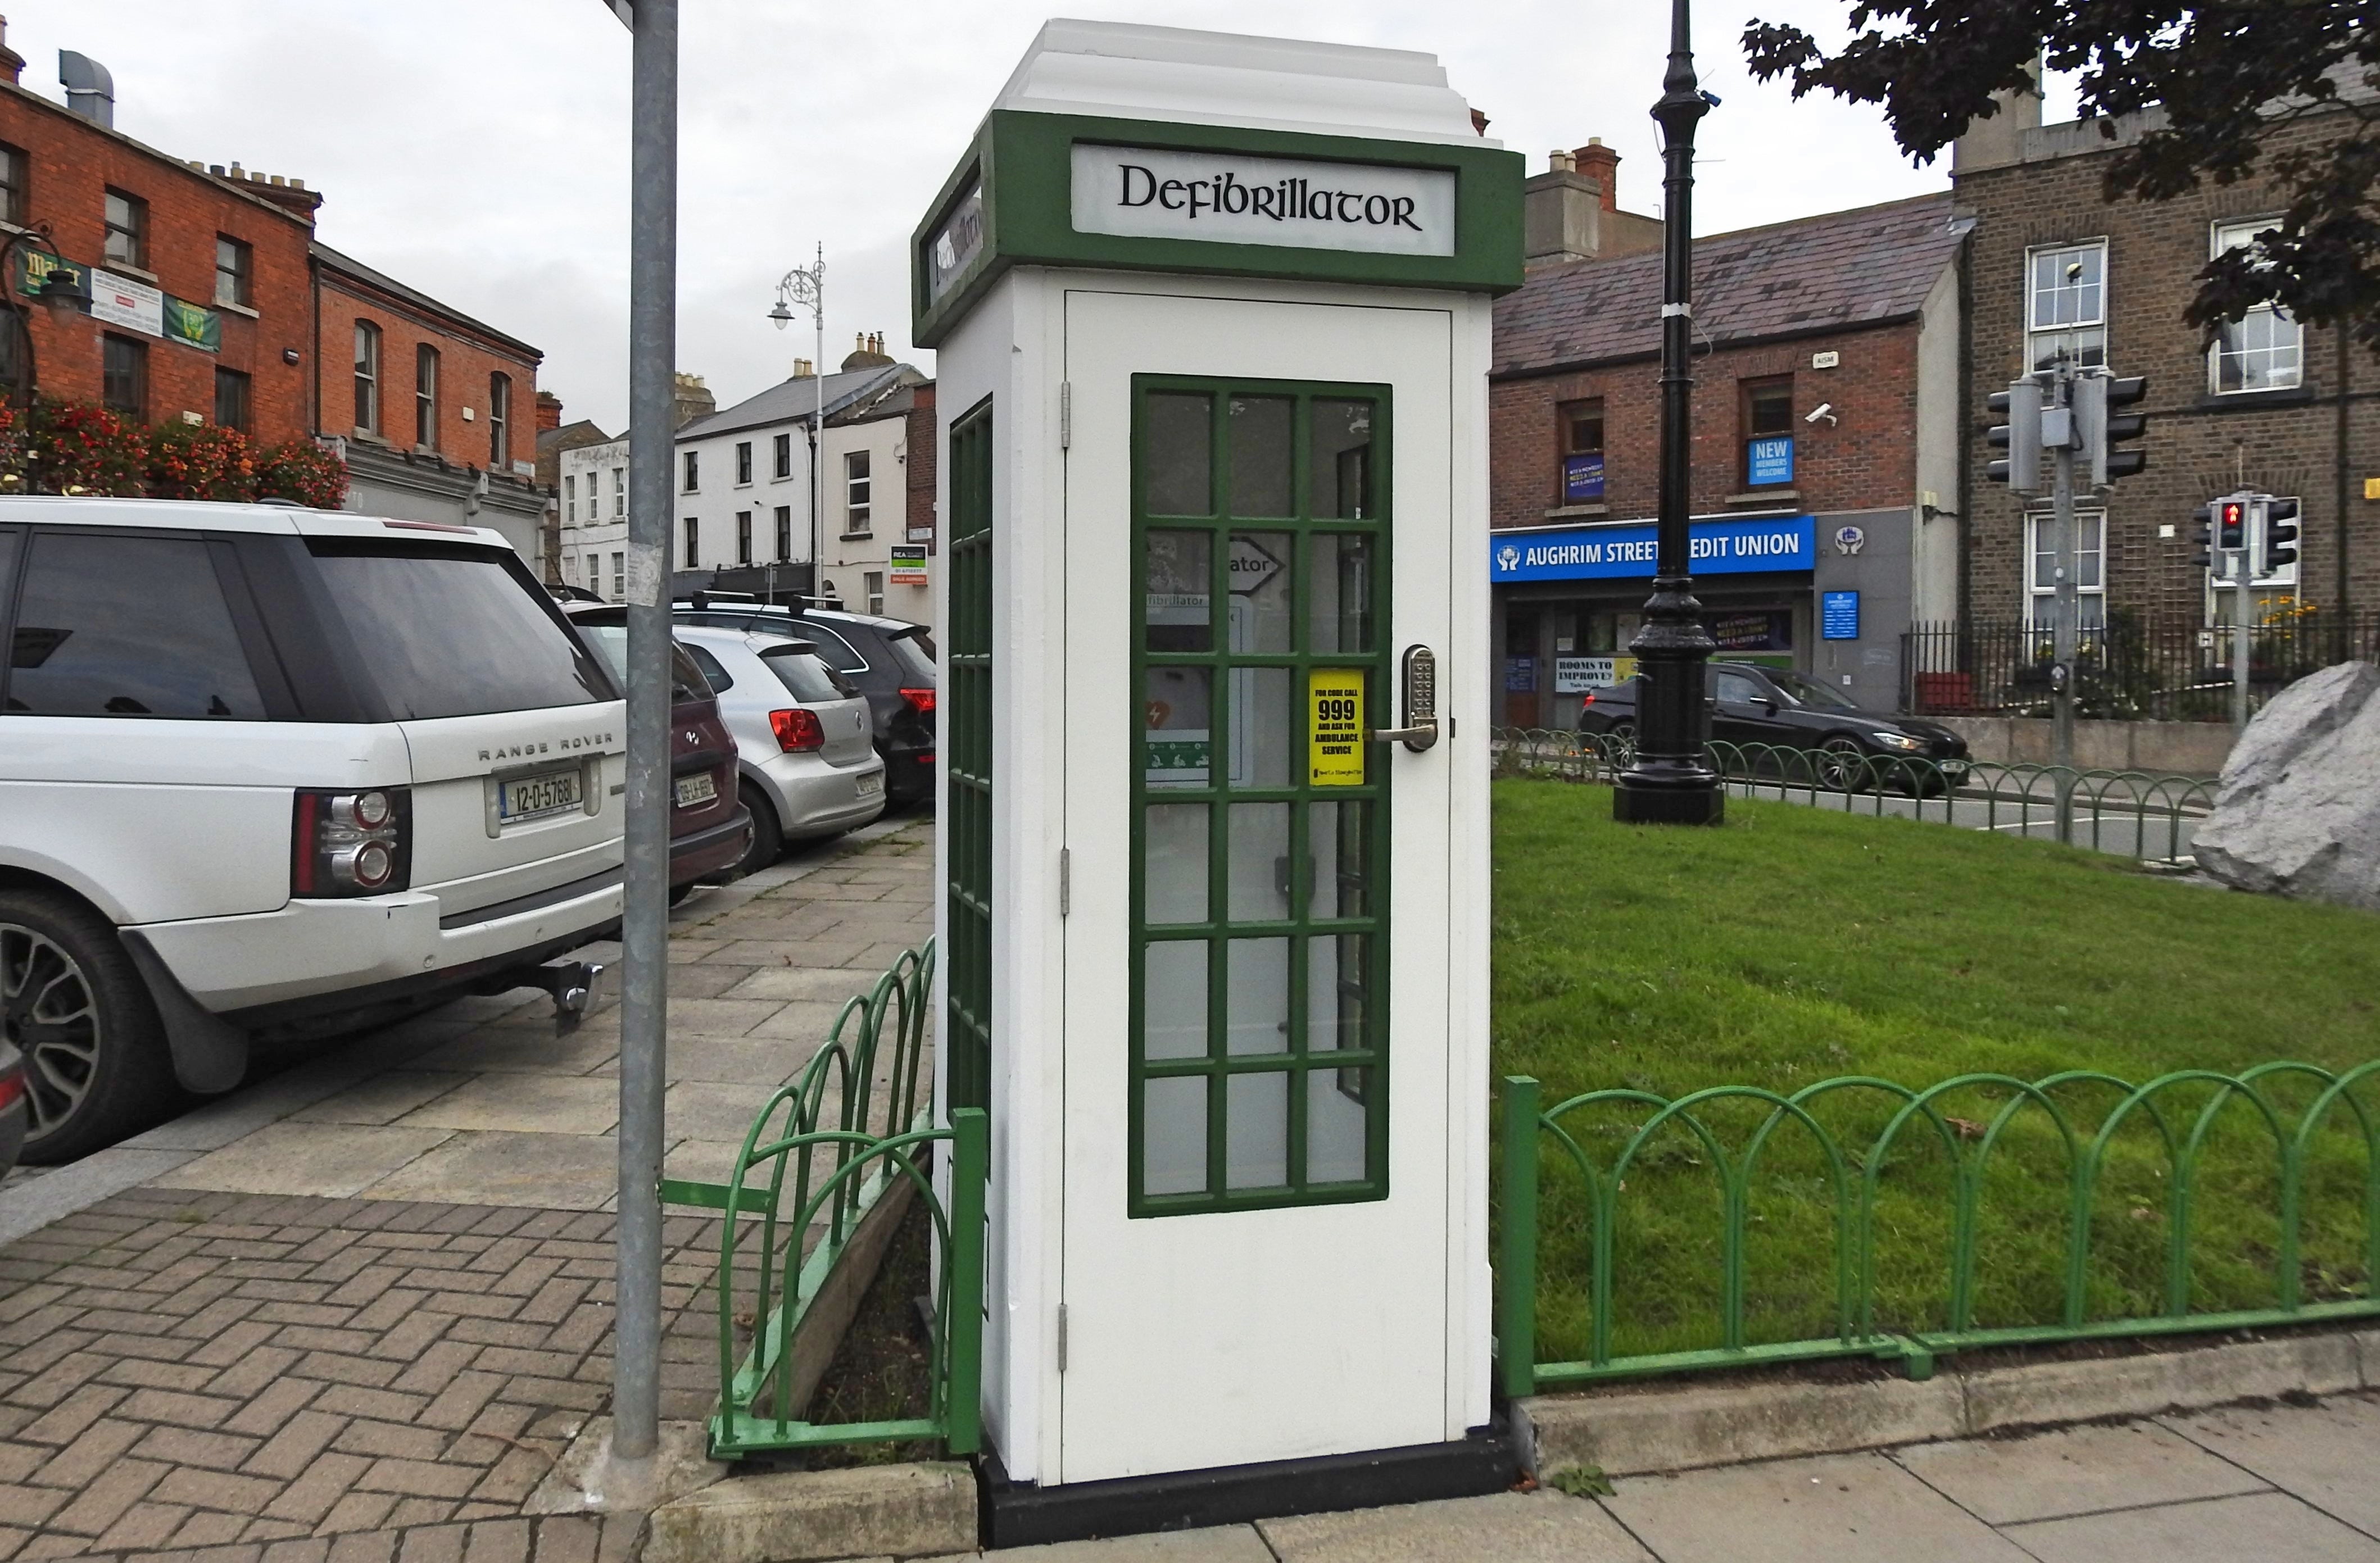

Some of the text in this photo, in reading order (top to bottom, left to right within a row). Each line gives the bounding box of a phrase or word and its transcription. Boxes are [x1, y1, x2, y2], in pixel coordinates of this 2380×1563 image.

[1117, 164, 1423, 231] Defibrillator
[1756, 440, 1787, 459] NEW
[1756, 458, 1787, 468] MEMBERS
[1757, 467, 1787, 476] WELCOME
[1526, 544, 1601, 566] AUGHRIM
[1689, 537, 1729, 558] EDIT
[1735, 533, 1798, 556] UNION
[1230, 556, 1269, 572] ator
[1148, 596, 1203, 605] fibrillator
[1559, 661, 1612, 670] ROOMS TO
[1558, 671, 1613, 680] IMPROVE?
[1318, 699, 1355, 721] 999
[1314, 733, 1359, 743] AMBULANCE
[478, 733, 613, 761] RANGE ROVER
[1321, 745, 1352, 755] SERVICE
